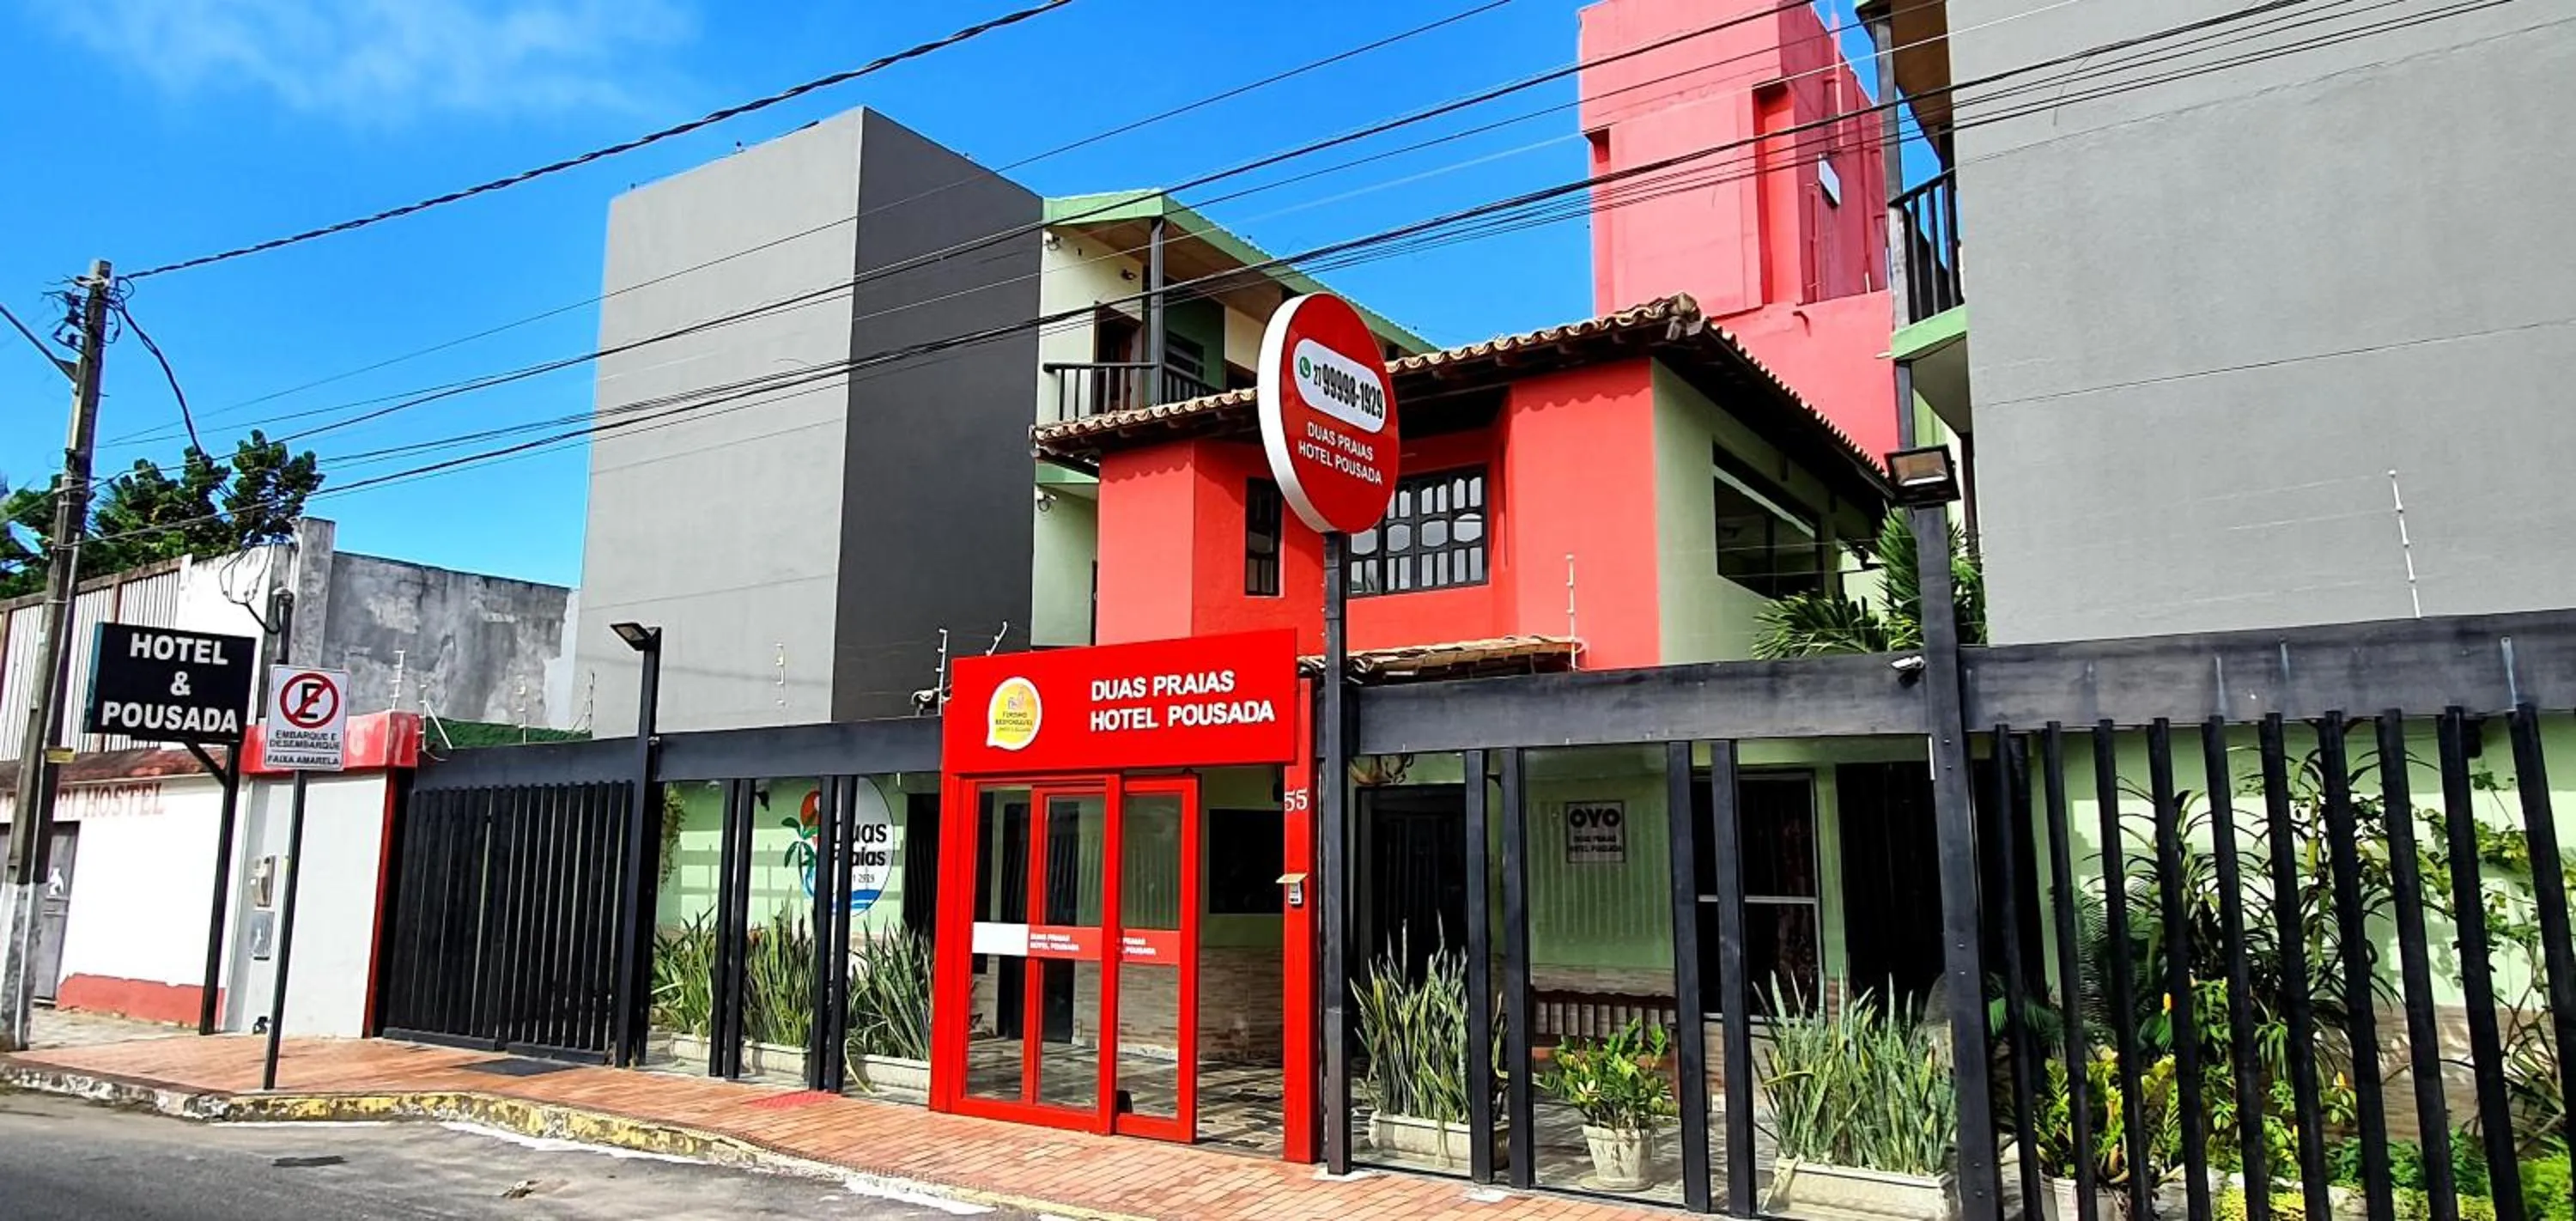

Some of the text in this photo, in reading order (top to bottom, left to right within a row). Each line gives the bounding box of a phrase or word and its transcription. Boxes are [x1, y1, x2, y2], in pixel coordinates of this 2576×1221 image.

[1313, 363, 1383, 419] 27 99998-1929
[1307, 422, 1374, 461] DUAS PRAIAS
[1297, 439, 1383, 485] HOTEL POUSADA
[130, 632, 228, 665] HOTEL
[170, 671, 191, 696] &
[1091, 670, 1235, 702] DUAS PRAIAS
[101, 700, 239, 733] POUSADA
[1090, 699, 1276, 732] HOTEL POUSADA
[270, 739, 340, 750] DESEMBARQUE
[276, 730, 328, 740] EMBARQUE
[268, 755, 339, 765] FAIXA AMARELA
[82, 782, 166, 819] HOSTEL
[1285, 788, 1308, 811] 55
